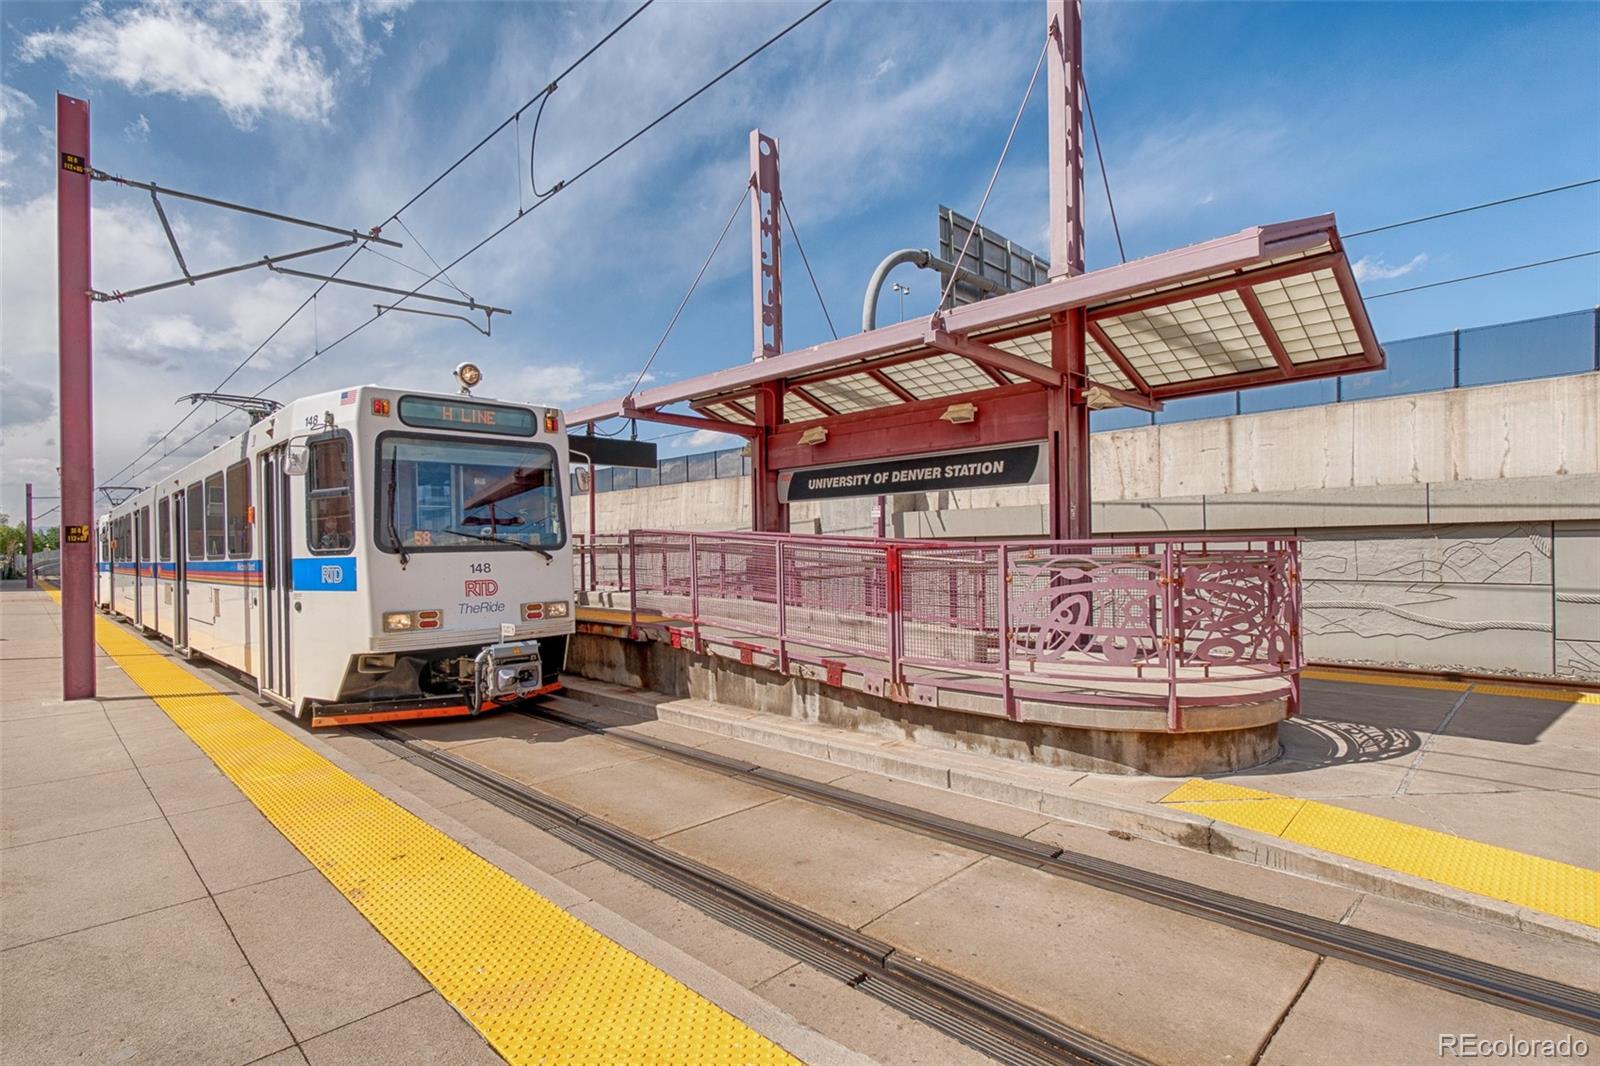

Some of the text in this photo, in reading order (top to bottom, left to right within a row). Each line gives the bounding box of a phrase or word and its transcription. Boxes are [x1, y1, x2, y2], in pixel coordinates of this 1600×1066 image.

[305, 415, 319, 427] 148
[442, 406, 497, 425] H LINE
[808, 473, 871, 490] UNIVERSITY
[873, 472, 889, 484] OF
[891, 467, 942, 483] DENVER
[944, 460, 1005, 478] STATION
[321, 565, 343, 584] RTD
[470, 562, 491, 574] 148
[464, 579, 499, 598] RTD
[458, 601, 506, 615] TheRide
